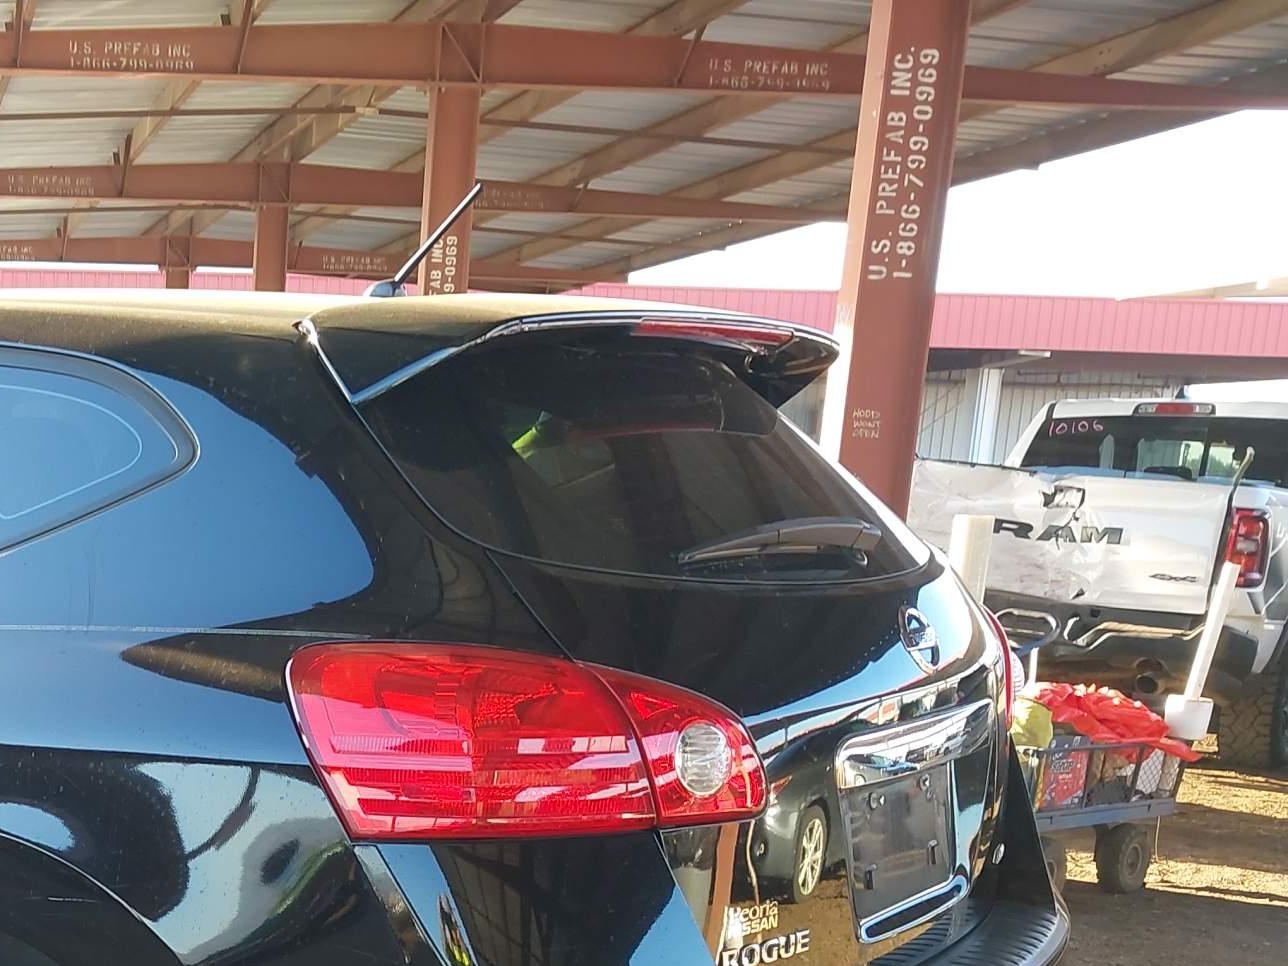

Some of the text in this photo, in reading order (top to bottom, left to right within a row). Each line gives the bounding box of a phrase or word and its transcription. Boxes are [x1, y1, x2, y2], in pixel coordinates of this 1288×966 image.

[104, 41, 160, 57] PREFAB
[744, 59, 799, 75] PREFAB
[867, 46, 915, 280] U.S. PREFAB INC.
[893, 48, 940, 278] 1-866-799-0969
[1048, 419, 1104, 437] 10106
[993, 518, 1124, 545] RAM
[728, 914, 778, 940] SSAN
